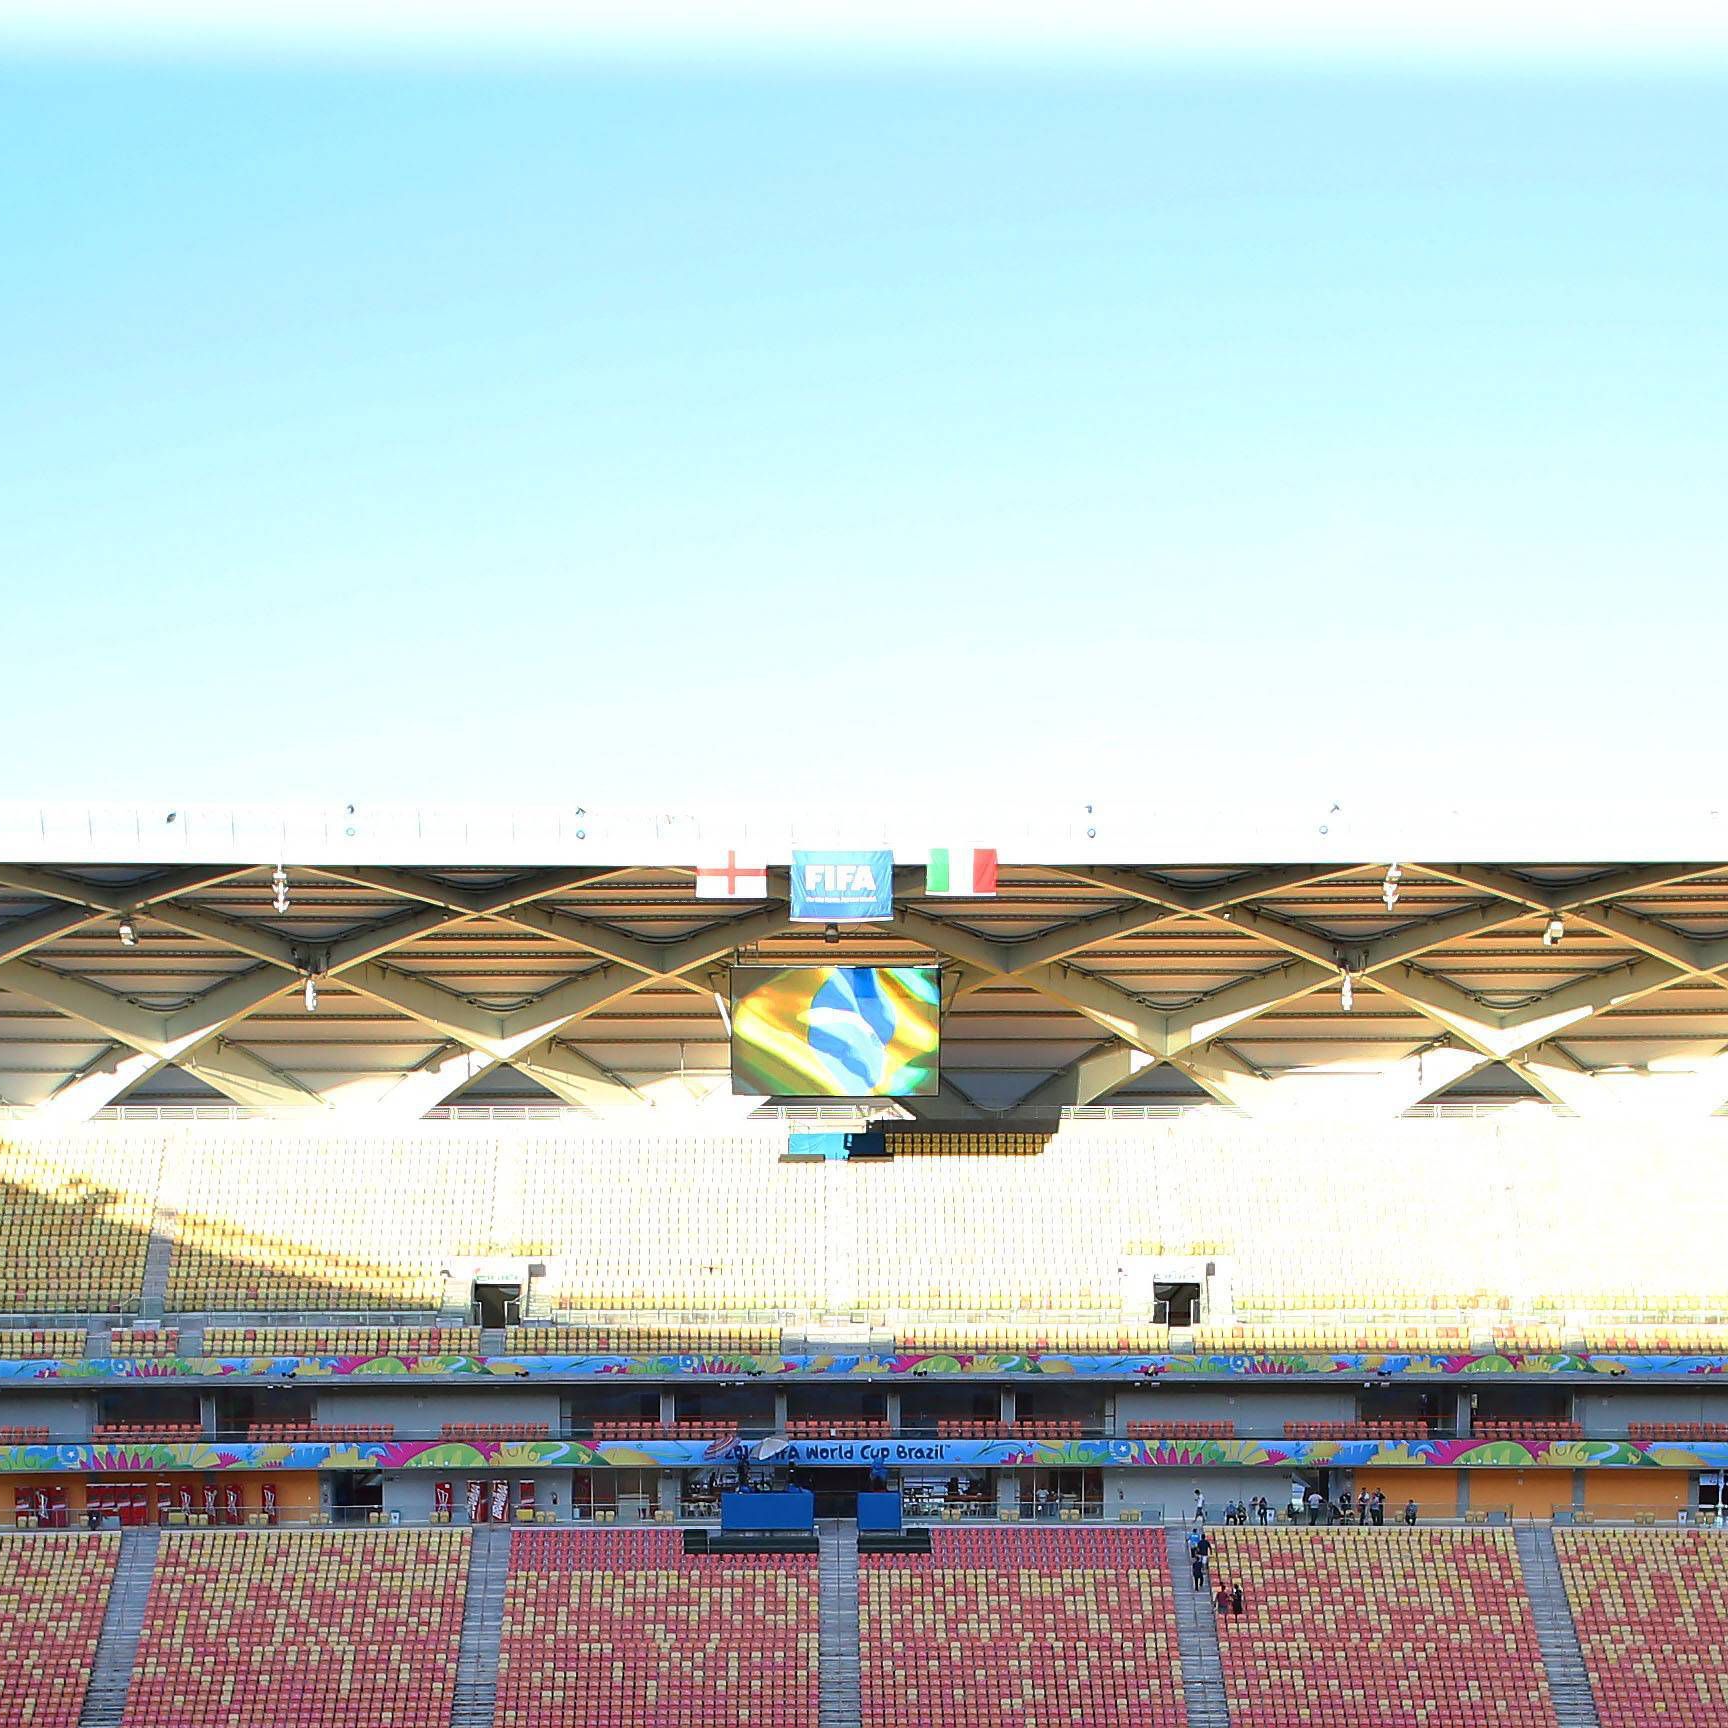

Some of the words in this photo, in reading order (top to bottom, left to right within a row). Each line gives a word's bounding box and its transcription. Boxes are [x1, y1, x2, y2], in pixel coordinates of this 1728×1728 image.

[805, 864, 877, 891] FIFA
[806, 1445, 853, 1460] World
[860, 1445, 890, 1461] Cup
